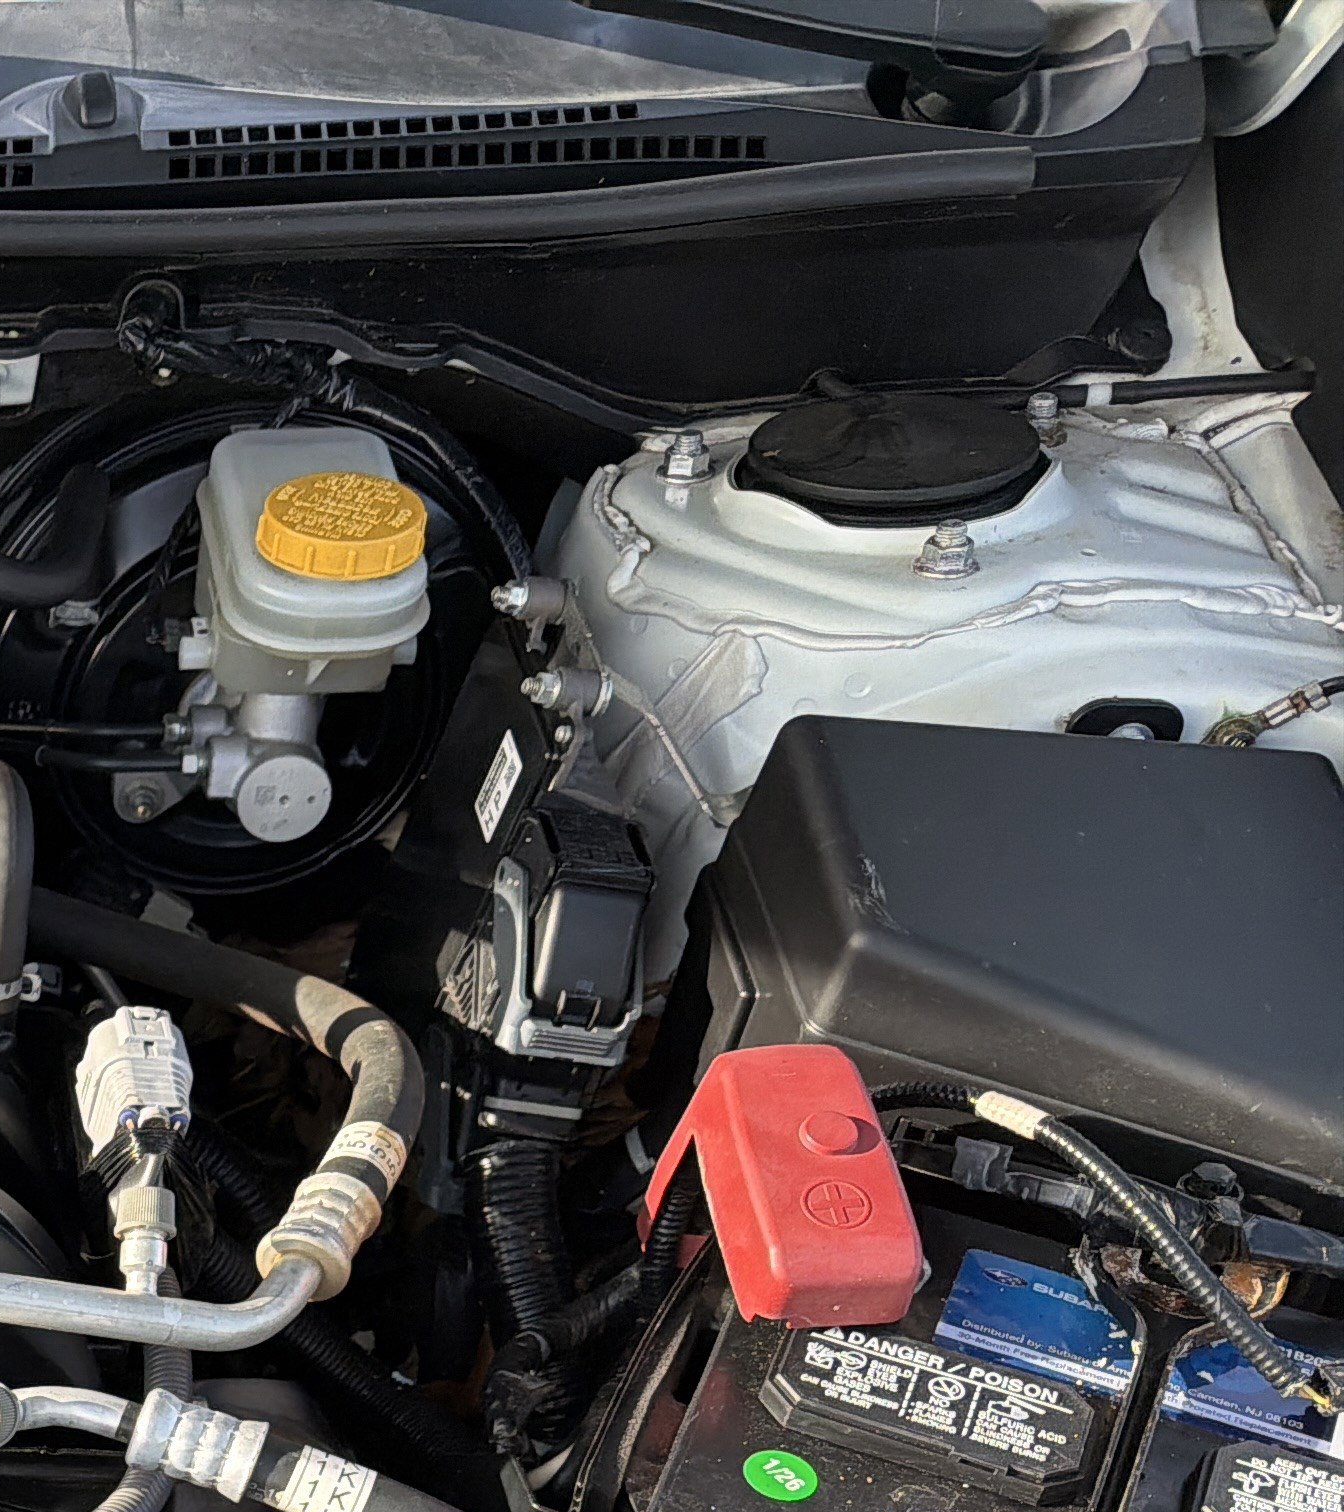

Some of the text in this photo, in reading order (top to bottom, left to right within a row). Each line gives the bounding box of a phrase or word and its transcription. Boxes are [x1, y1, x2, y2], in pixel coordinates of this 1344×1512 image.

[962, 1319, 1025, 1344] Distributed
[1026, 1338, 1044, 1351] by:
[1048, 1345, 1090, 1365] Subaru
[846, 1330, 1059, 1404] DANGER / POISON
[866, 1367, 898, 1383] EYES
[869, 1359, 913, 1379] SHIELD
[833, 1375, 871, 1393] GASES
[835, 1366, 899, 1393] EXPLOSIVE
[928, 1396, 950, 1408] NO
[1188, 1388, 1242, 1412] Camden,
[1244, 1405, 1263, 1418] NJ
[1265, 1412, 1305, 1431] 08103
[975, 1418, 997, 1431] CAN
[977, 1410, 1067, 1445] SULFURIC ACID
[1033, 1444, 1051, 1456] OR
[762, 1457, 805, 1492] 1/26
[1250, 1456, 1291, 1476] DO NOT
[1304, 1466, 1329, 1480] OUT
[337, 1467, 359, 1488] K
[1277, 1477, 1312, 1496] FLUSH
[327, 1486, 352, 1512] K
